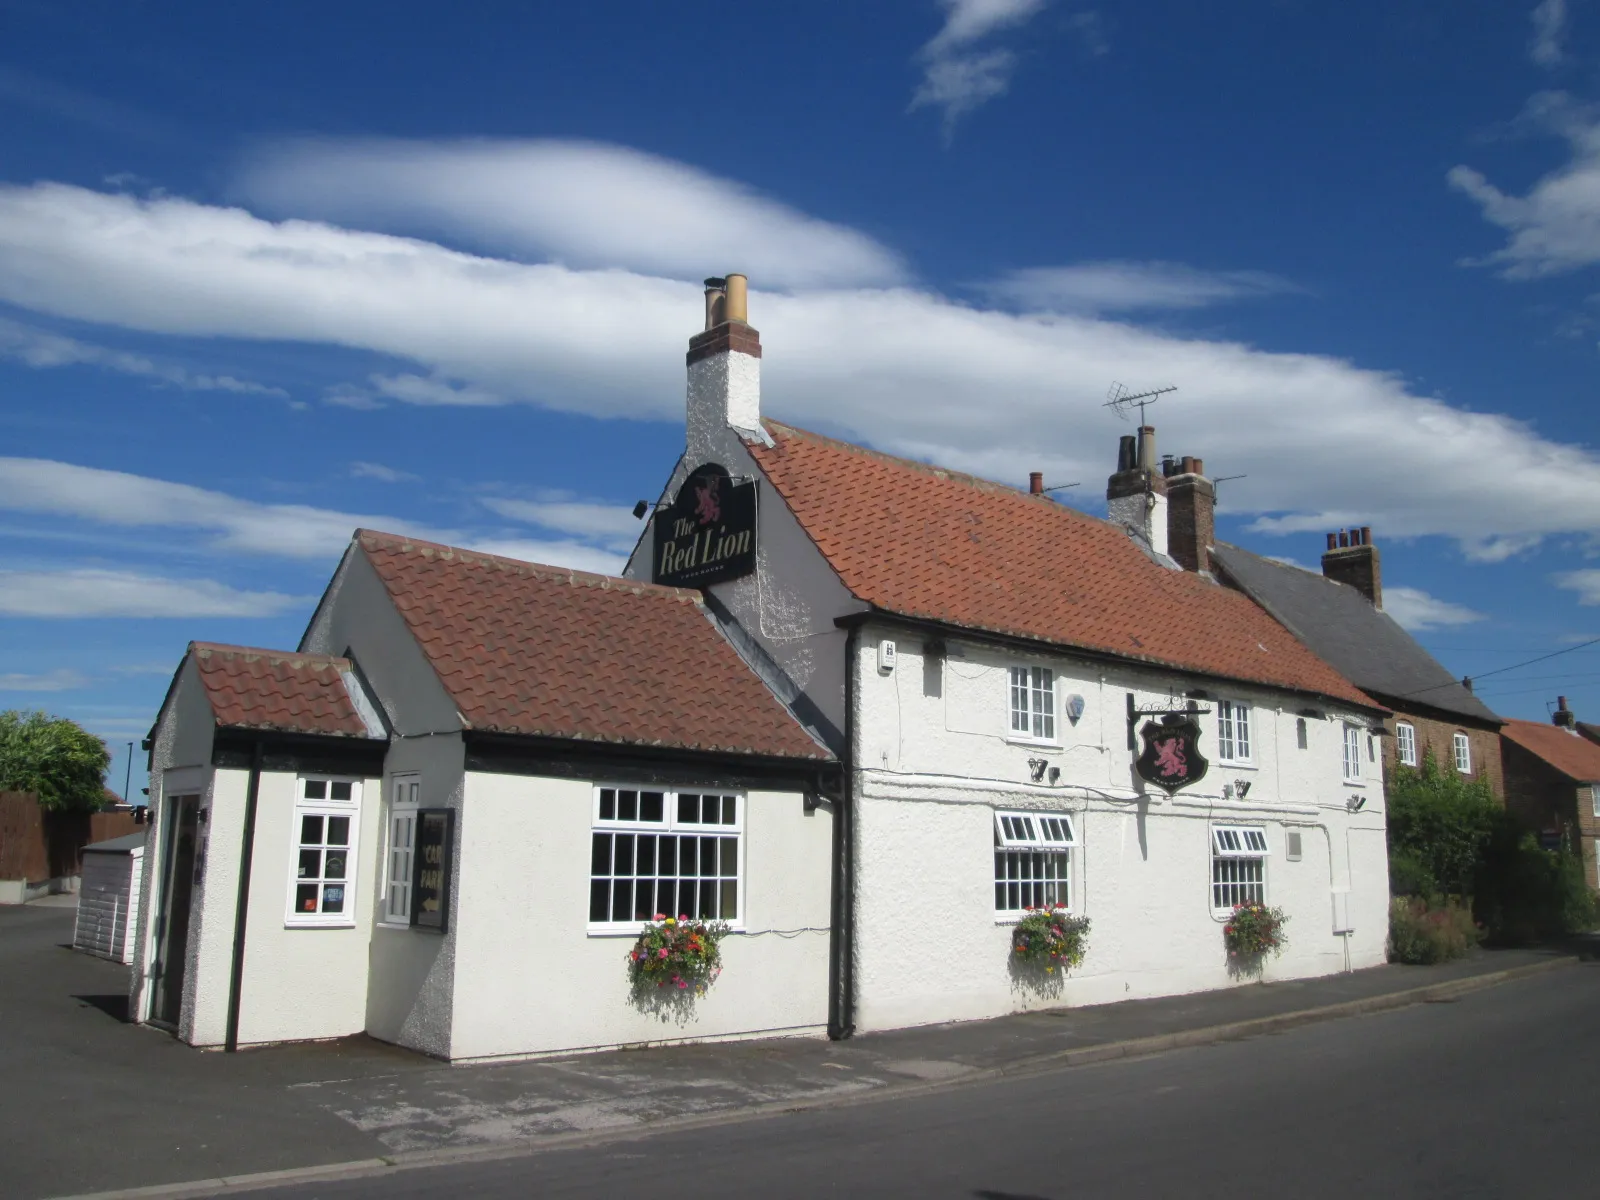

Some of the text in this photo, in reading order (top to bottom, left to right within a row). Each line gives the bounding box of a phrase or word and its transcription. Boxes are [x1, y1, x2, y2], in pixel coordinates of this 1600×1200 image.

[674, 517, 695, 539] The
[660, 525, 750, 575] Red Lion
[425, 844, 442, 864] CAR
[421, 869, 444, 889] PARK
